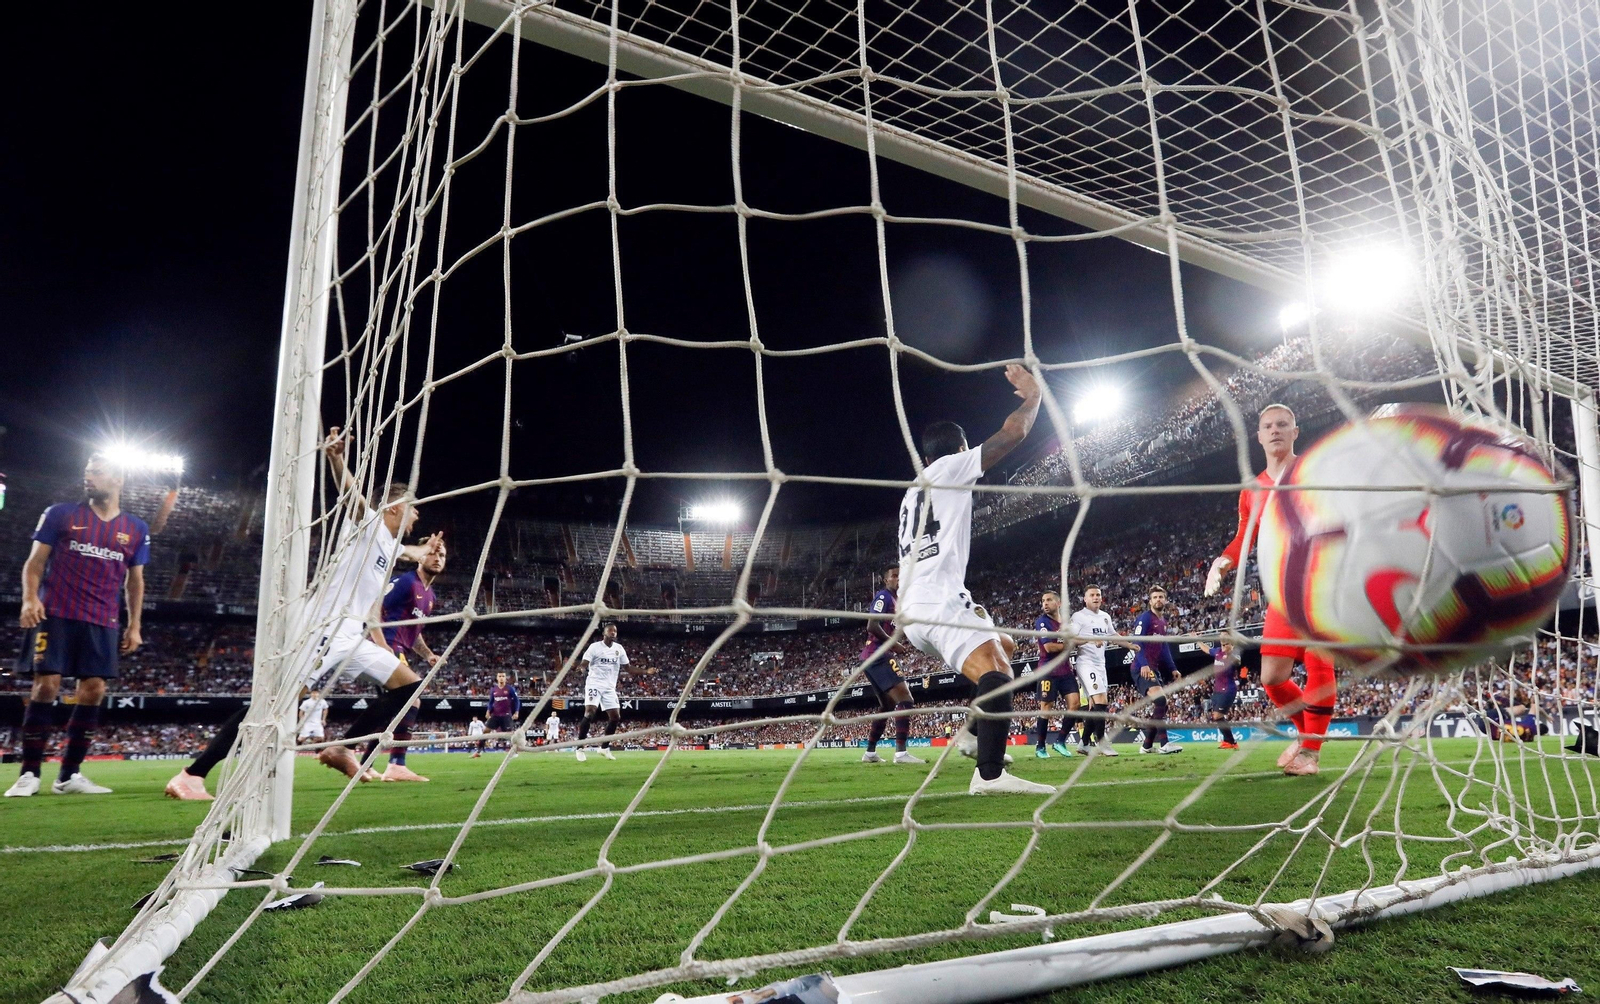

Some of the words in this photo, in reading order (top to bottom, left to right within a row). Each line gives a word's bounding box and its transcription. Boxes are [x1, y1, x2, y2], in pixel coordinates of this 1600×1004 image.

[69, 540, 124, 562] Rakuten
[35, 632, 48, 653] 5
[889, 659, 900, 671] 2
[1089, 672, 1098, 682] 9
[588, 688, 598, 696] 23
[1040, 680, 1051, 692] 18
[130, 753, 191, 761] SAMSUNG
